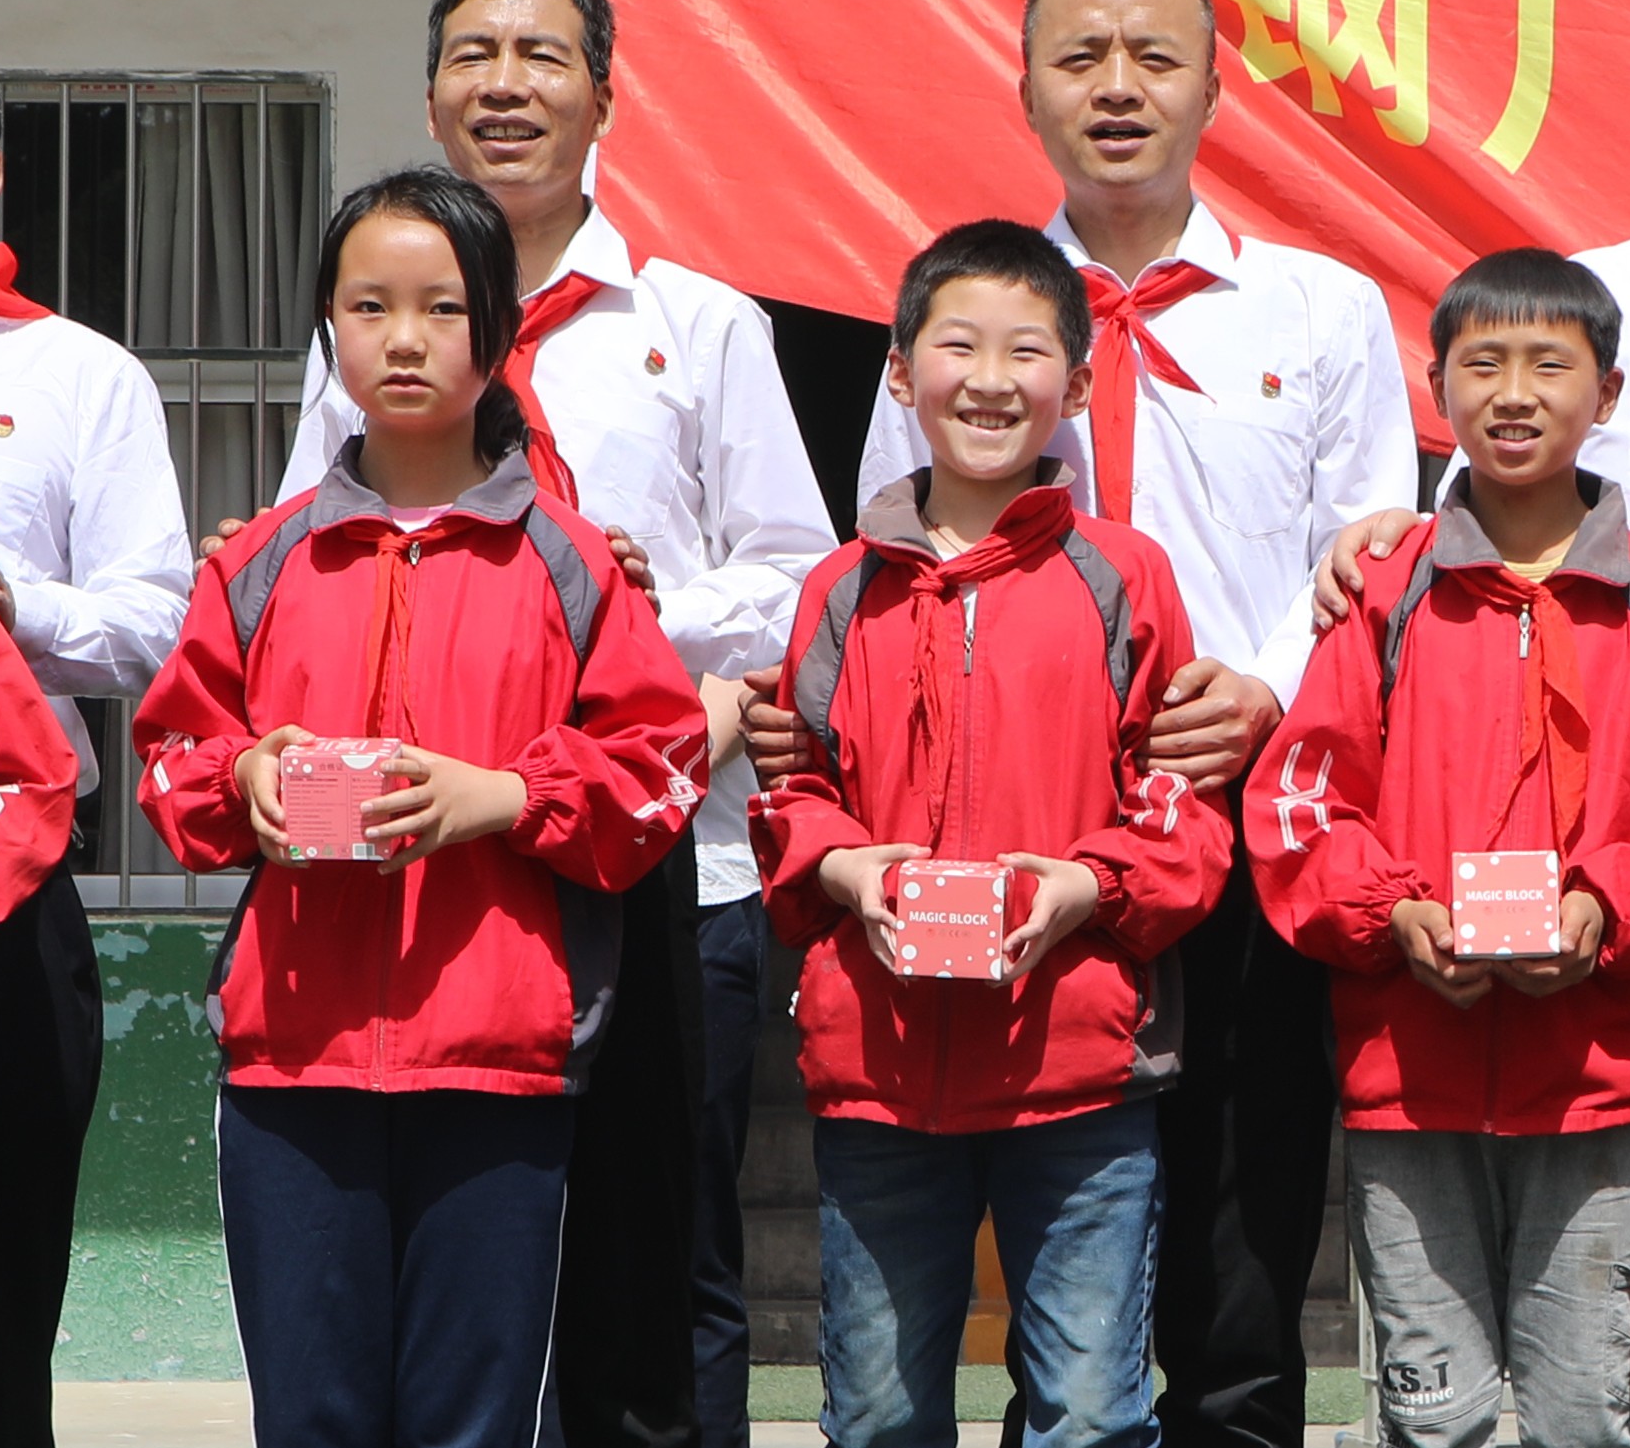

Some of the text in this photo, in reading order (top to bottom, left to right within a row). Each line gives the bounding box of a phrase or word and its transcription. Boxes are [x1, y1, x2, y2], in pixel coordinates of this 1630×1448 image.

[1465, 888, 1545, 902] MAGIC BLOCK
[909, 910, 989, 926] MAGIC BLOCK
